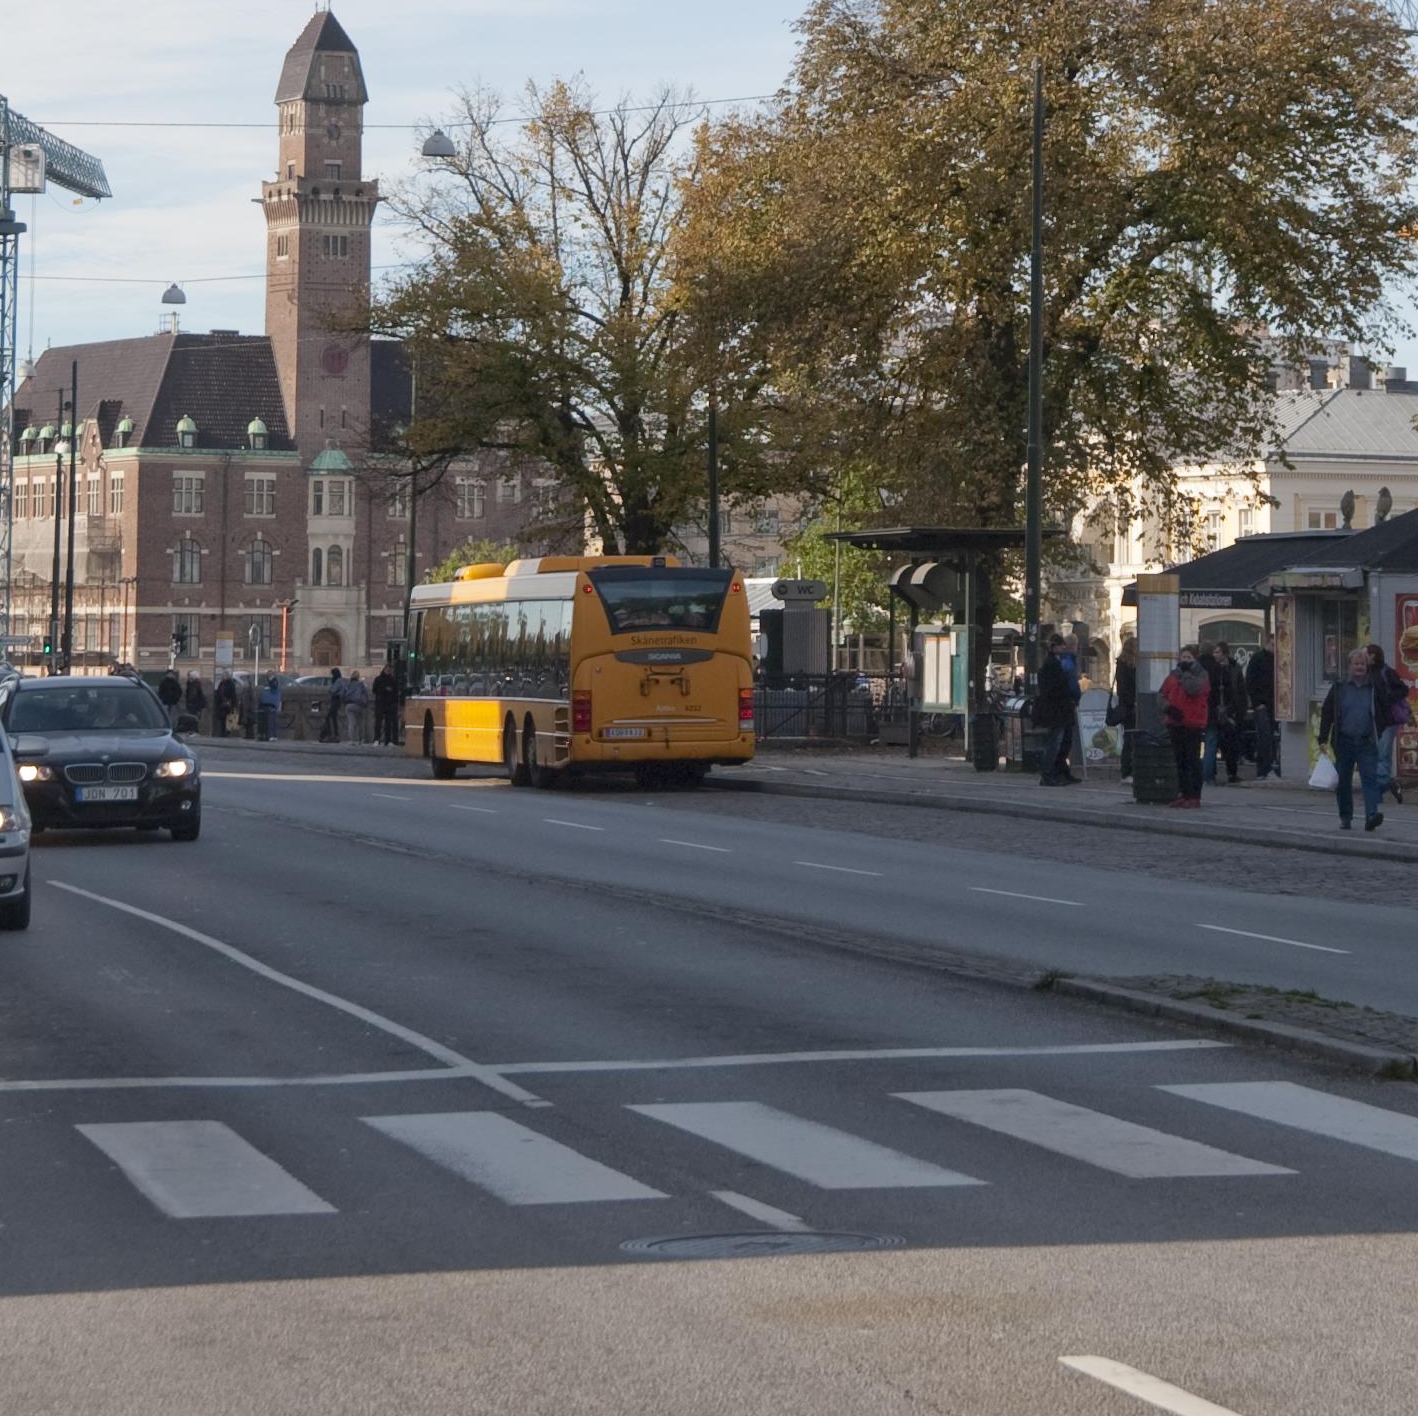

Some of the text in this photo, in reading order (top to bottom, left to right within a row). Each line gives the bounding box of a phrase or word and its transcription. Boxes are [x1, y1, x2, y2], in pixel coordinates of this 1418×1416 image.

[797, 585, 814, 594] WC
[631, 635, 697, 645] Skånetrafiken
[648, 653, 682, 661] SCANIA
